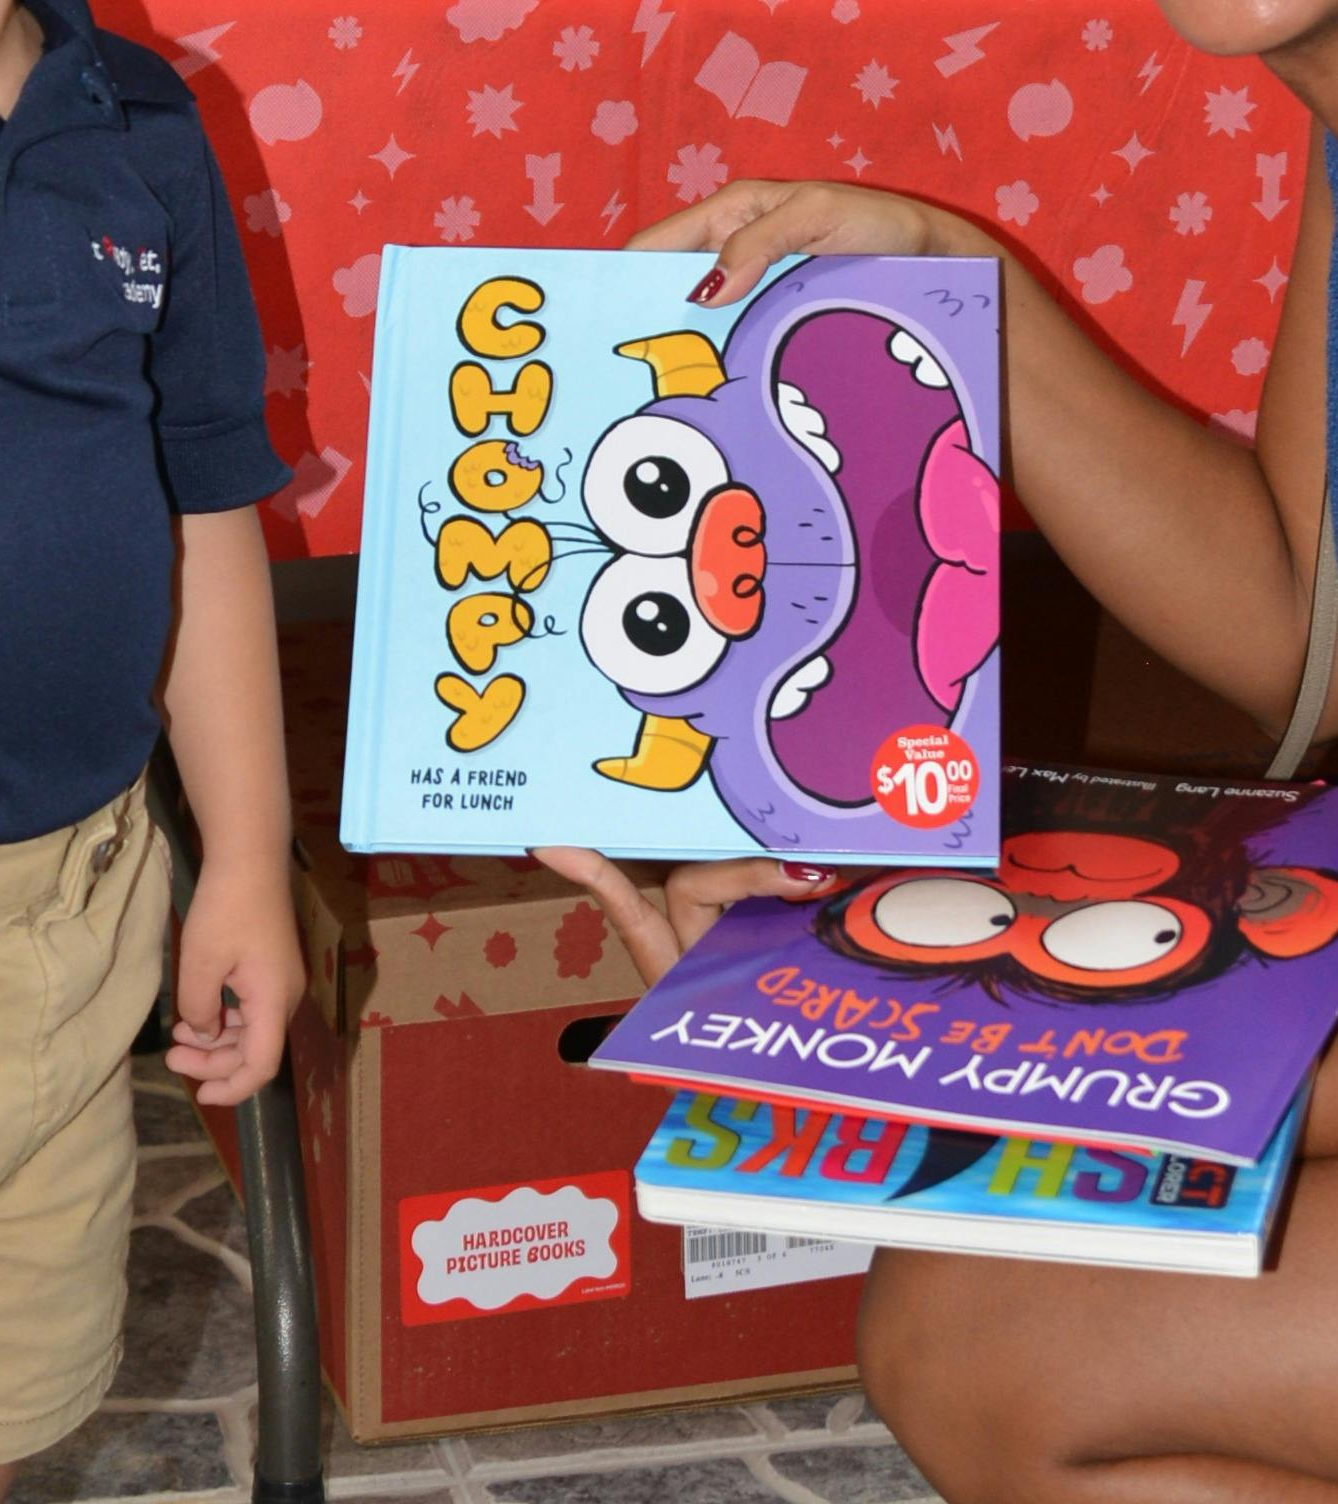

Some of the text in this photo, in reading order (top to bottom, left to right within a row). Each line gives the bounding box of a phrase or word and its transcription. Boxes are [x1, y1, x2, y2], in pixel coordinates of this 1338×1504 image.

[434, 274, 554, 754] CHOMPY
[897, 735, 949, 750] Special
[904, 749, 945, 761] Value
[410, 767, 528, 787] HAS A FRIEND
[1031, 768, 1070, 784] Max
[1072, 771, 1087, 783] by
[1090, 774, 1157, 791] Illustrated
[947, 783, 969, 793] Final
[1174, 781, 1219, 798] Lang
[1224, 785, 1300, 803] Suzanne
[421, 792, 514, 811] FOR LUNCH
[947, 793, 972, 804] Price
[756, 966, 1188, 1065] DON'T BE SCARED
[650, 1010, 1231, 1119] GRUMPY MONKEY
[462, 1221, 569, 1252] HARDCOVER
[445, 1238, 586, 1275] PICTURE BOOKS
